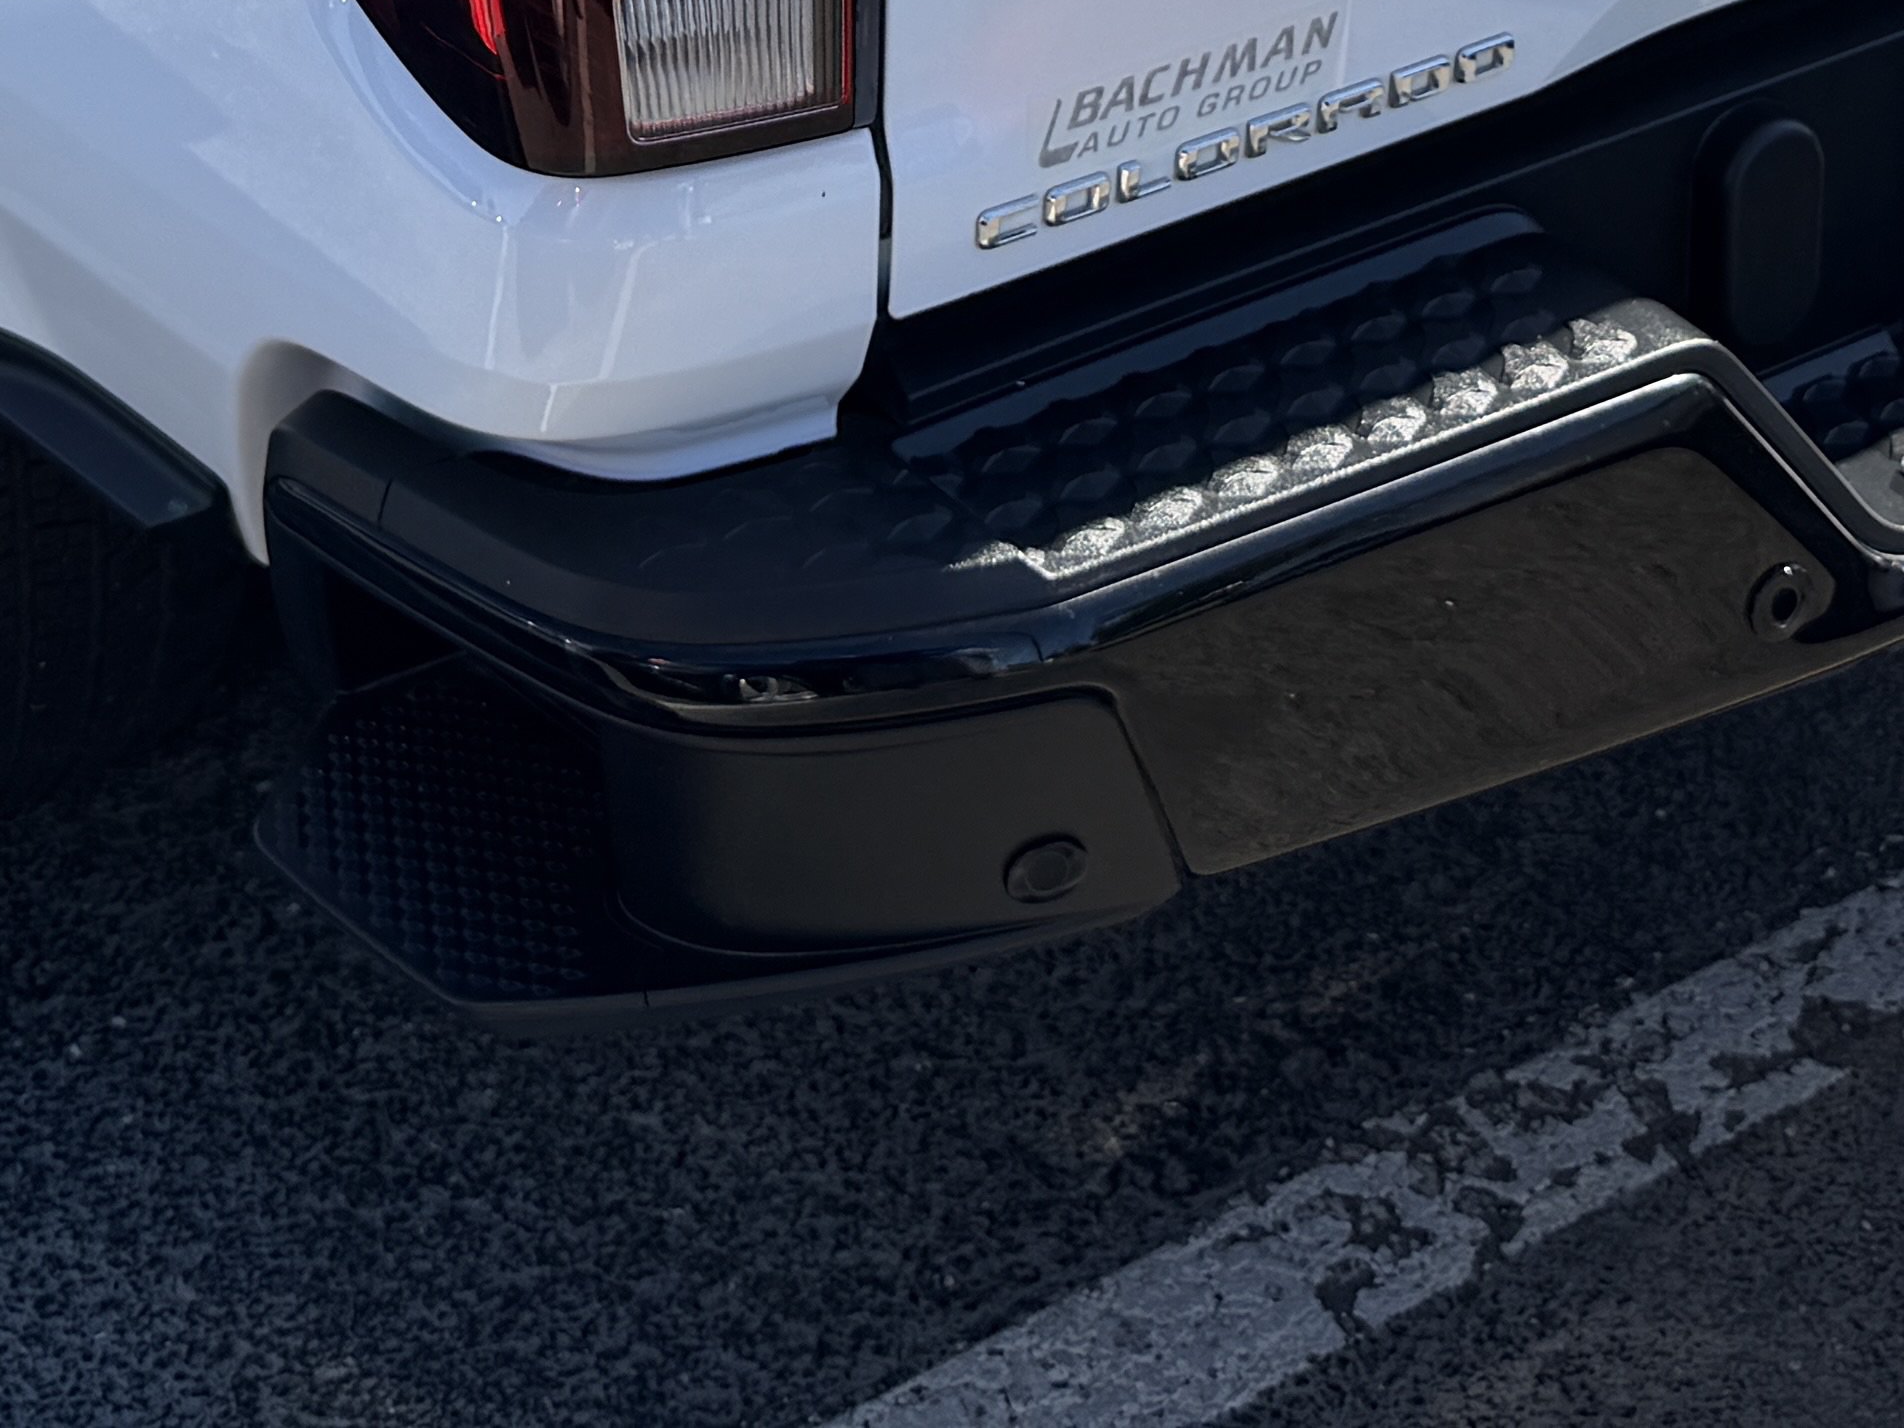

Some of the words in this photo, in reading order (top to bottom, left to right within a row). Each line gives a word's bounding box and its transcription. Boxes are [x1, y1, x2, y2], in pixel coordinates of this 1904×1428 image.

[1066, 10, 1339, 130] BACHMAN
[1076, 105, 1181, 158] AUTO
[1197, 59, 1324, 116] GROUP
[975, 30, 1516, 250] COLORADO
